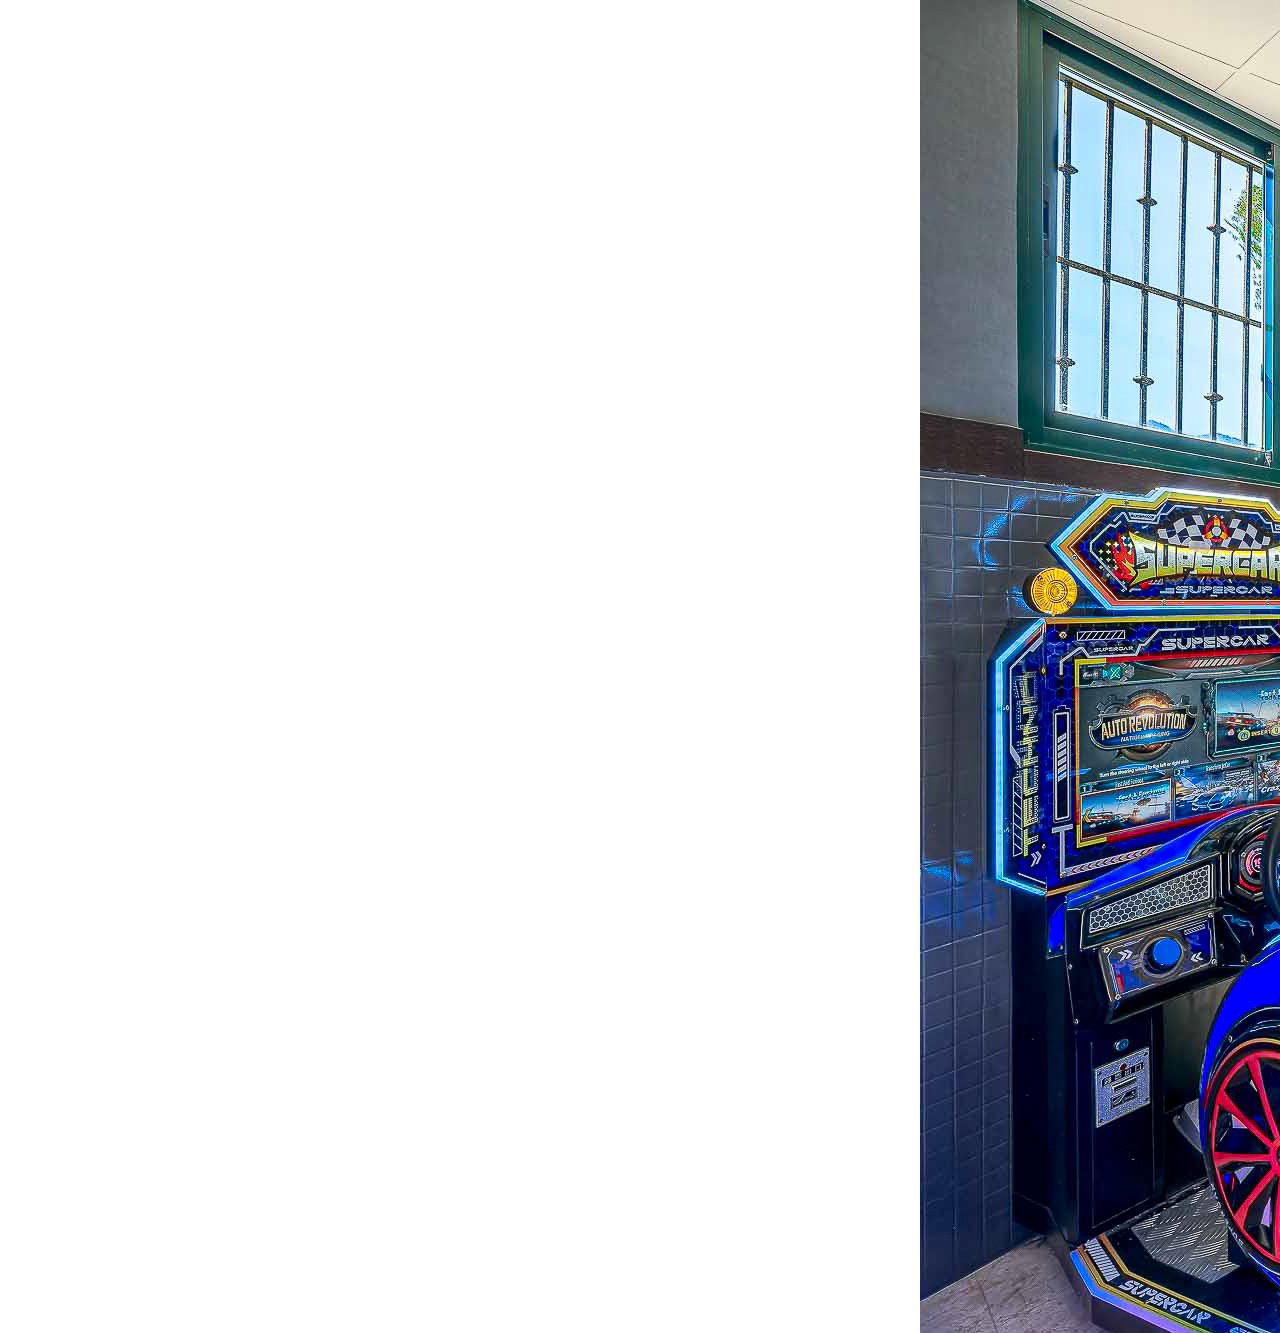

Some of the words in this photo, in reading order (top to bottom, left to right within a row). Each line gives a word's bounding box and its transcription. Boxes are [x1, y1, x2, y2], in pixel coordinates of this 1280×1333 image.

[1175, 586, 1272, 595] SUPERCAR
[1161, 633, 1270, 651] SUPERCAR
[1101, 718, 1128, 740] AUTO
[1129, 713, 1187, 732] REVOLUTION
[1118, 1278, 1212, 1325] SUPERCAR
